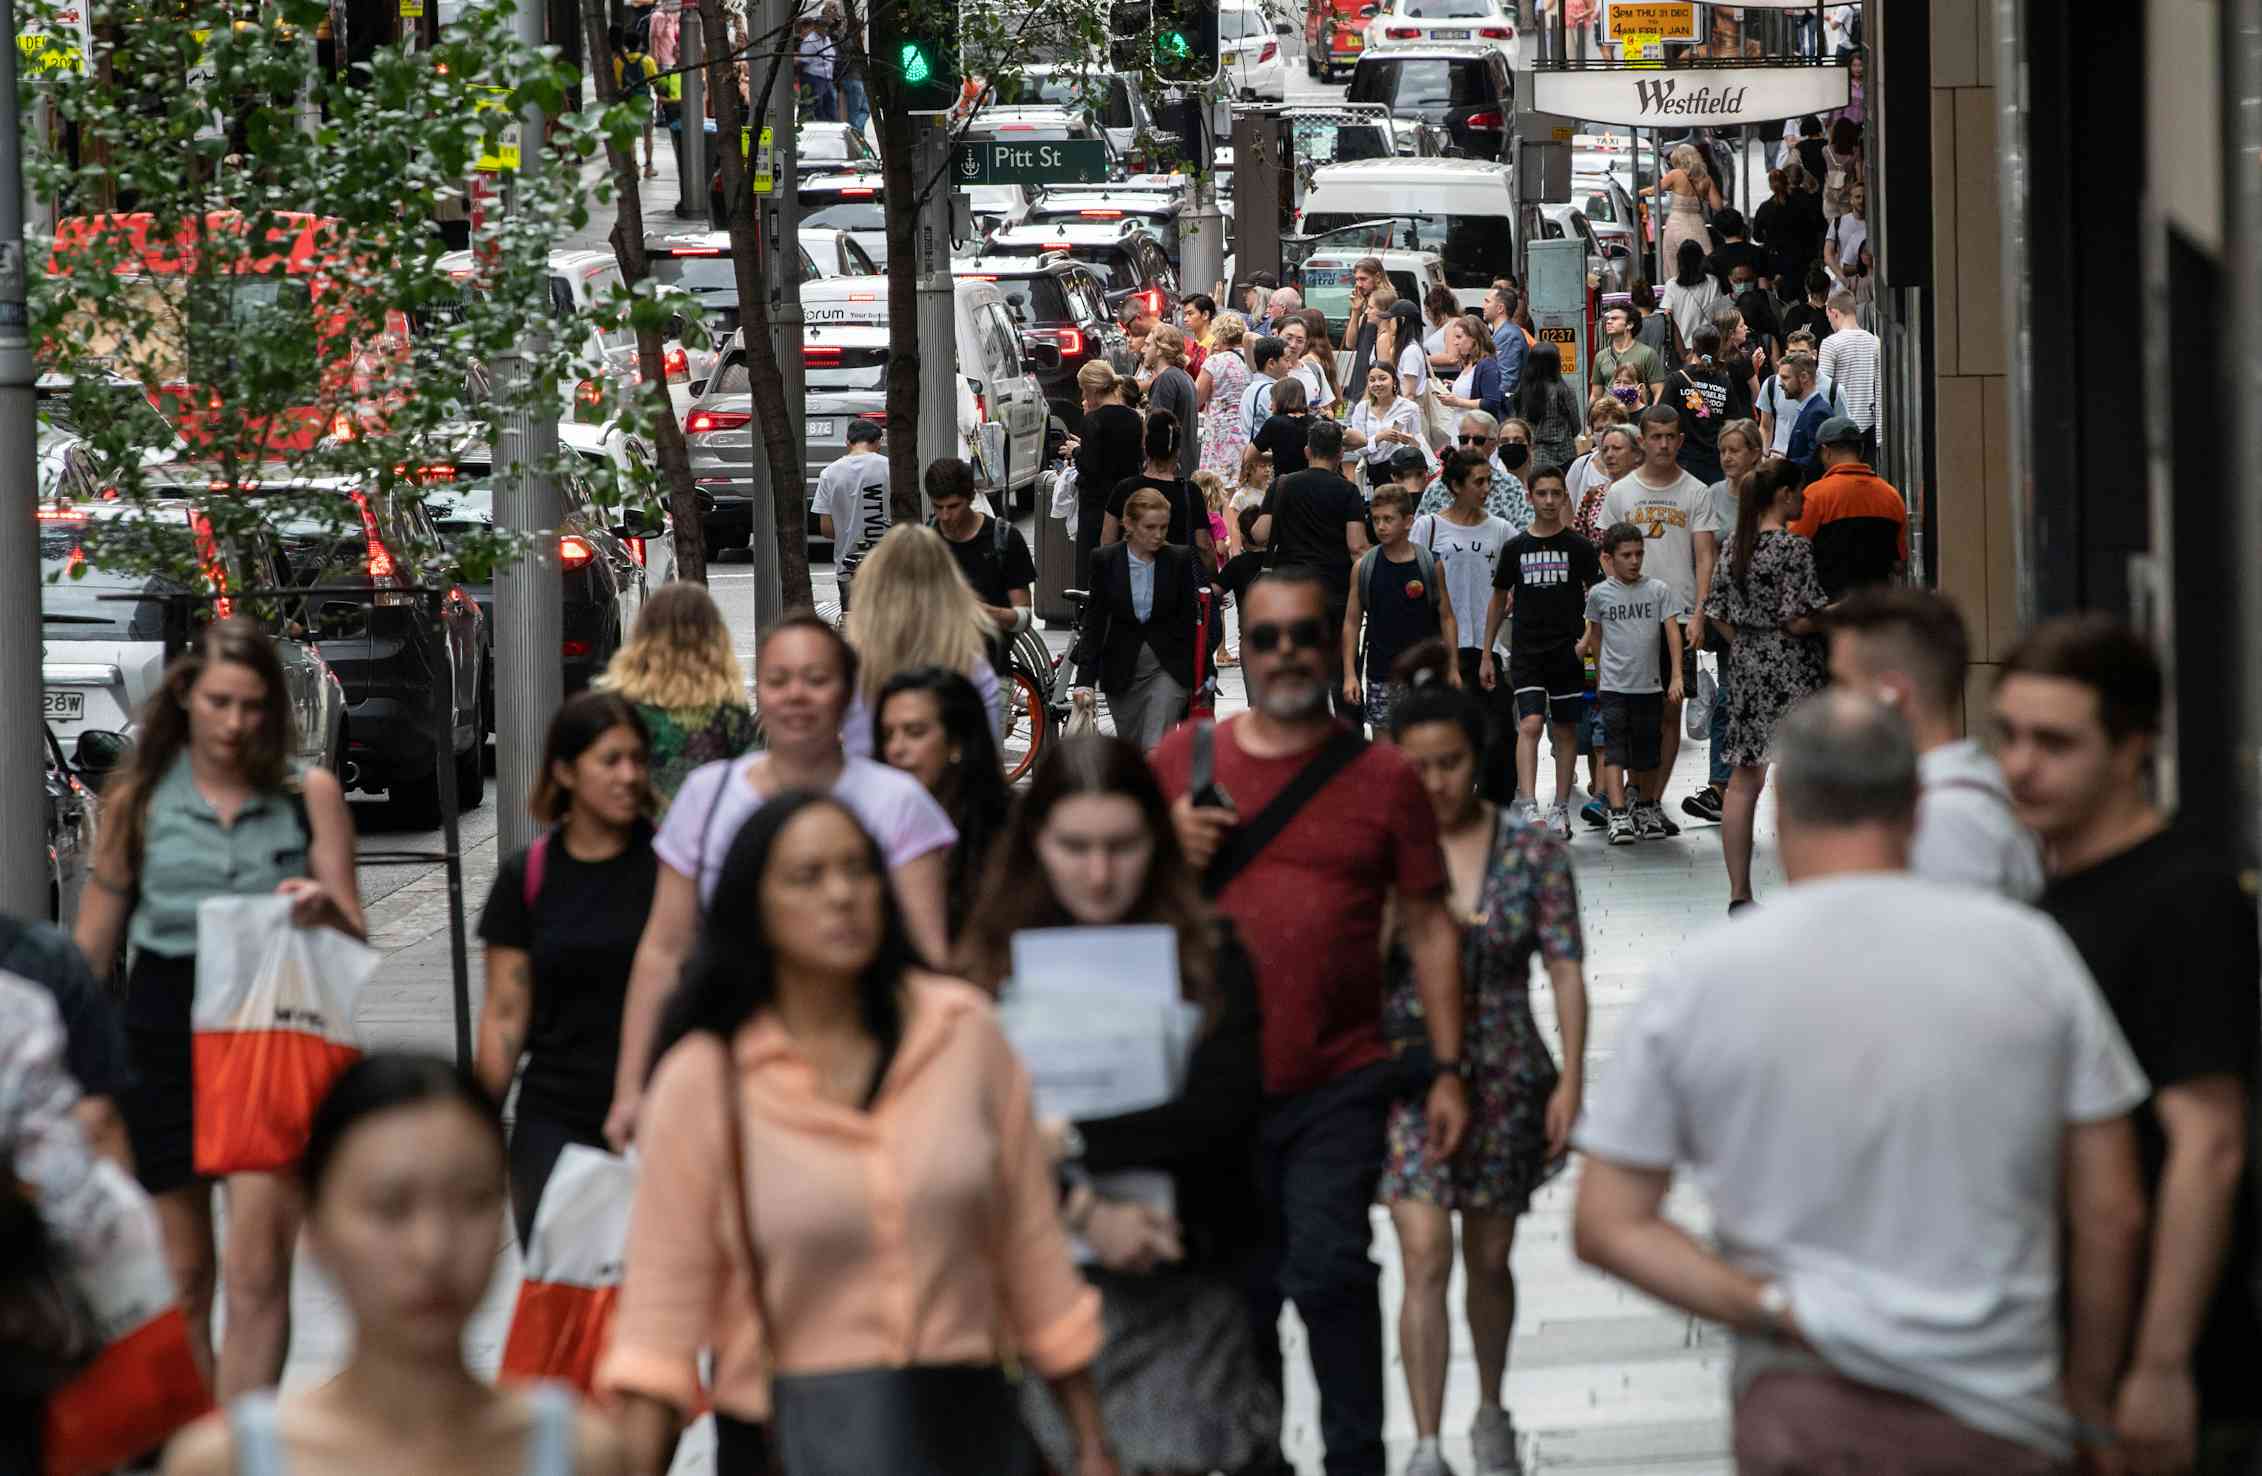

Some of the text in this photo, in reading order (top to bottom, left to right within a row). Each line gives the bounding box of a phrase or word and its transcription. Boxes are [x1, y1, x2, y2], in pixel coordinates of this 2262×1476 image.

[1637, 8, 1655, 17] THU
[1671, 8, 1689, 17] DEC
[1669, 26, 1690, 35] JAN
[1633, 78, 1749, 115] Westfield
[1595, 137, 1619, 145] TAXI
[995, 146, 1062, 168] Pitt St
[803, 304, 844, 320] orum
[1541, 330, 1573, 342] 0237
[1709, 383, 1727, 394] YORK
[1609, 602, 1652, 622] BRAVE
